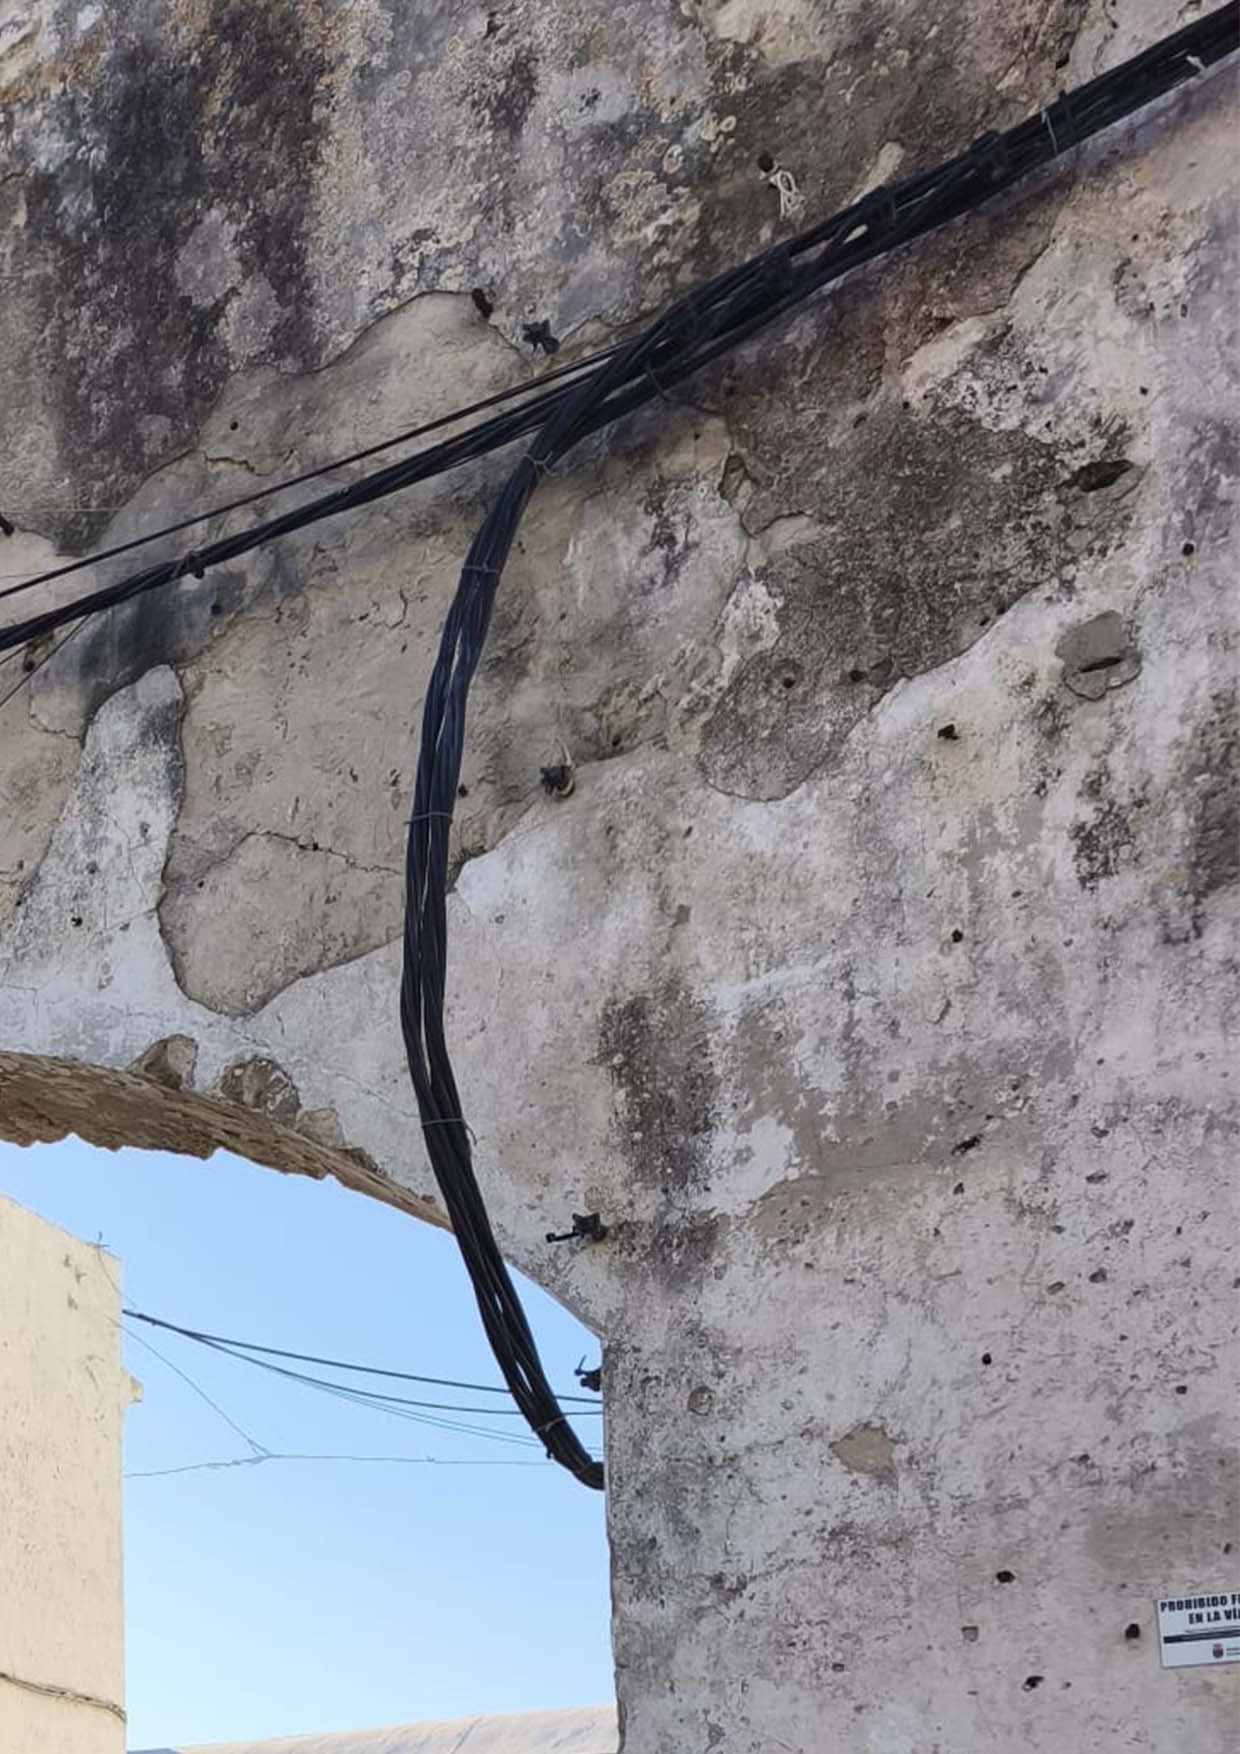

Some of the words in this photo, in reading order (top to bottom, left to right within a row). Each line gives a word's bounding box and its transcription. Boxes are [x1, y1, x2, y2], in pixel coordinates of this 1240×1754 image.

[1160, 1595, 1228, 1612] PROHIBIDO
[1188, 1613, 1203, 1624] EN
[1207, 1611, 1221, 1622] LA
